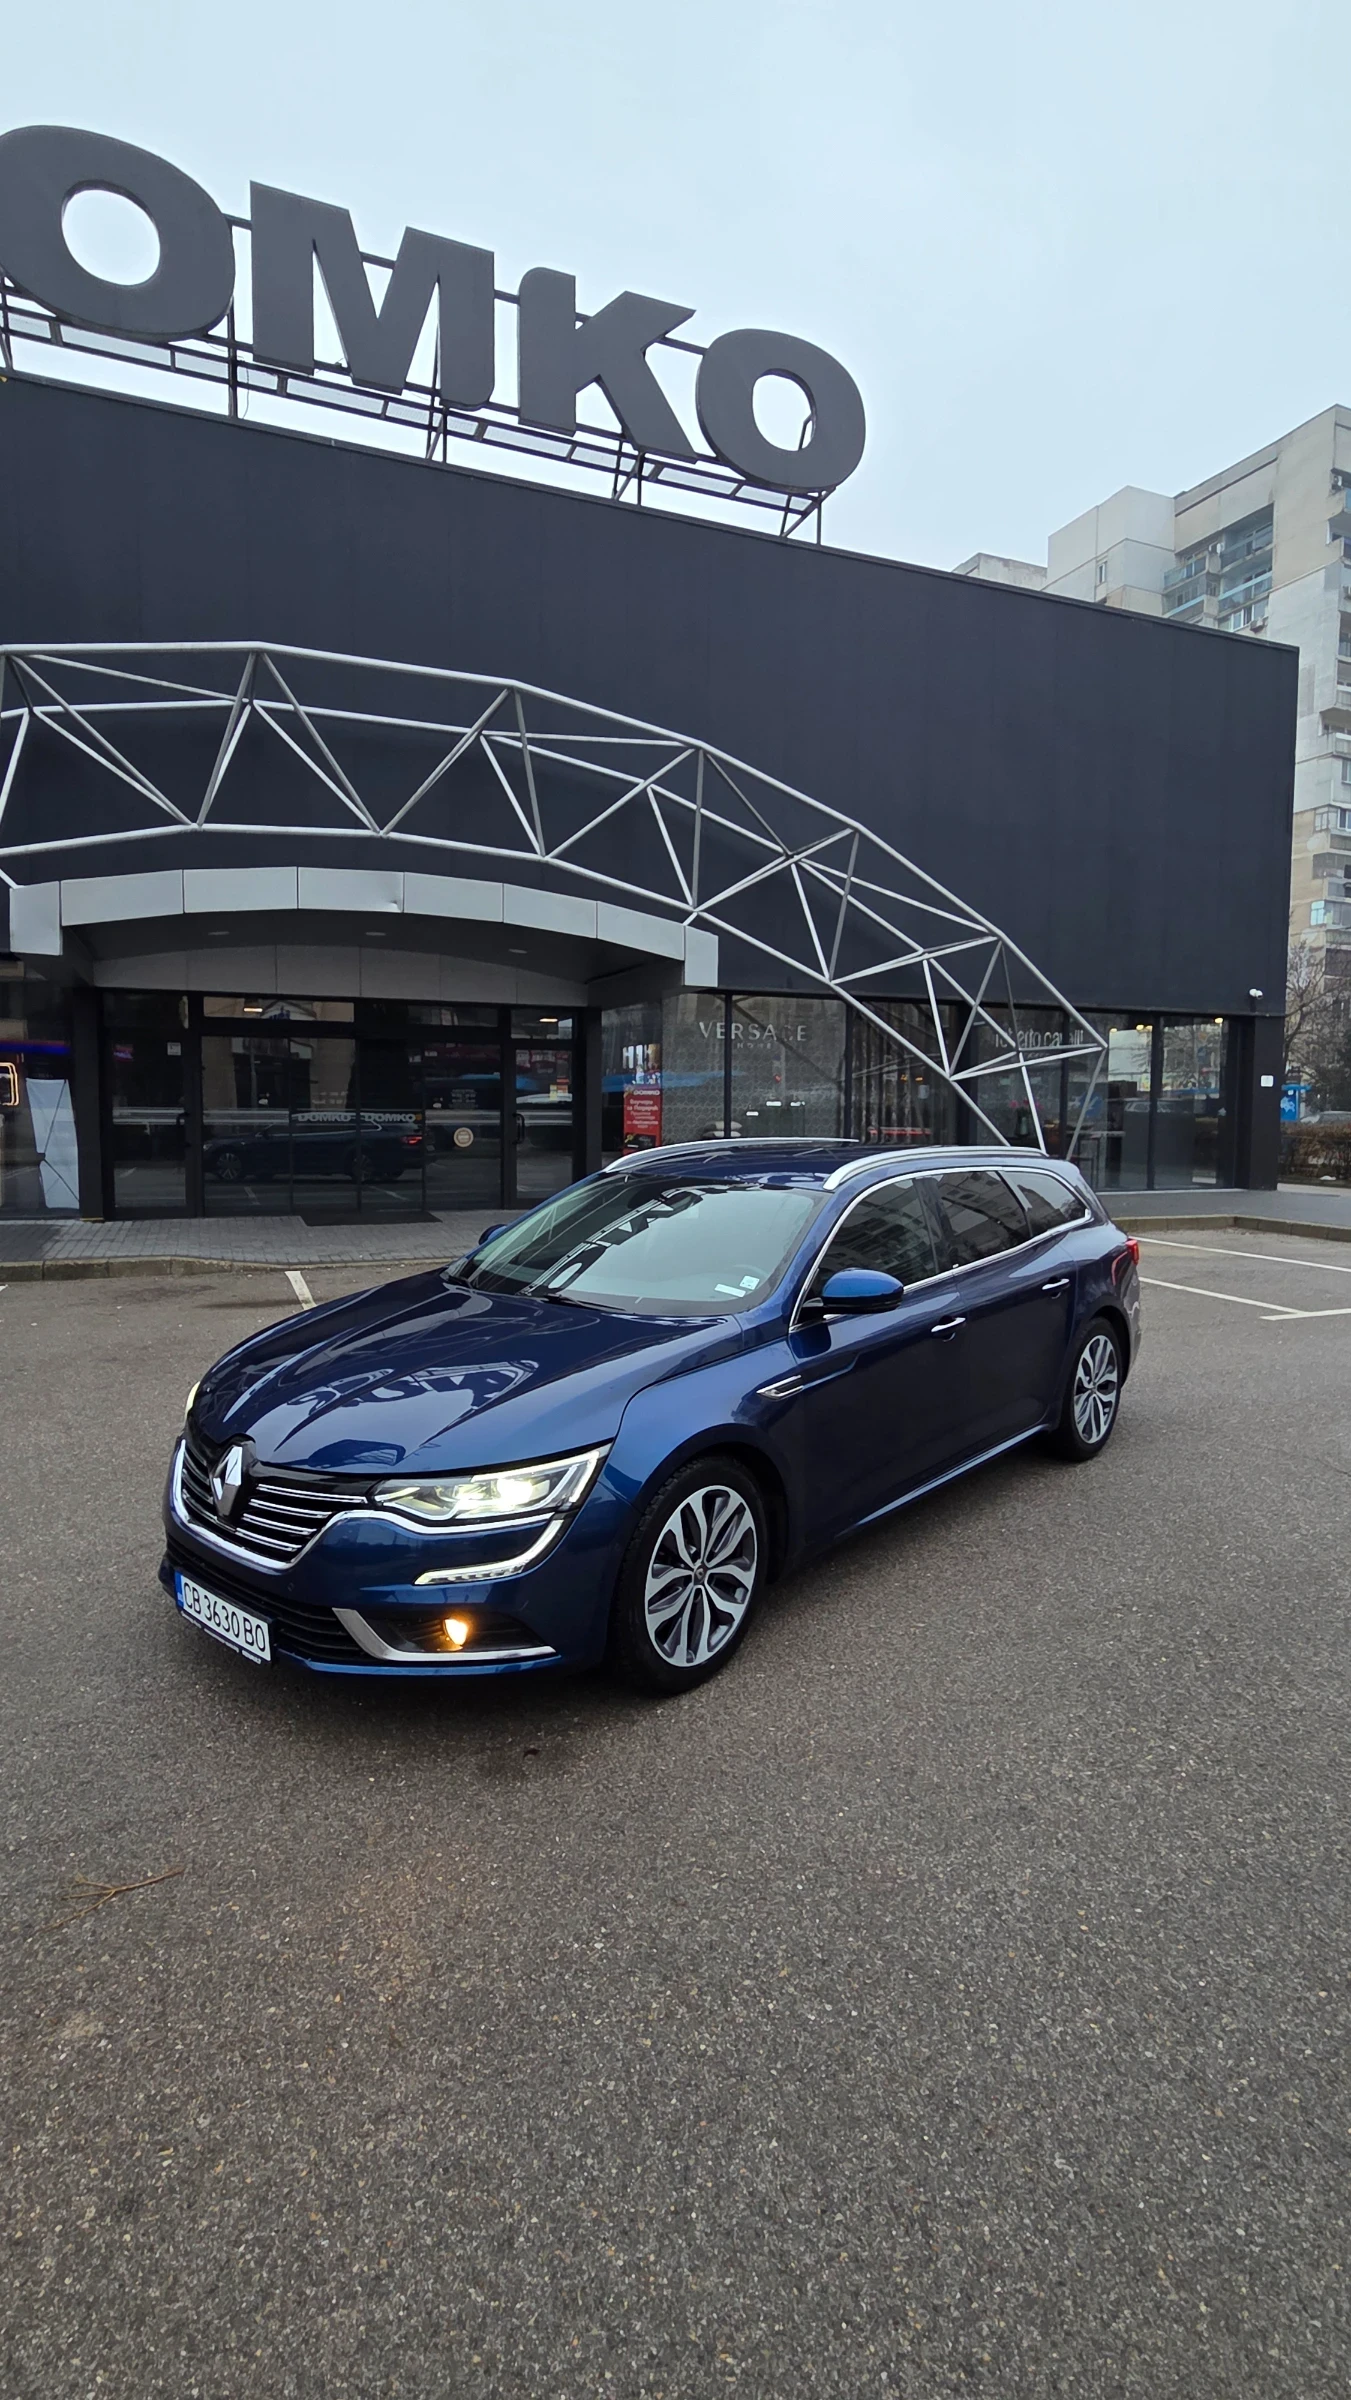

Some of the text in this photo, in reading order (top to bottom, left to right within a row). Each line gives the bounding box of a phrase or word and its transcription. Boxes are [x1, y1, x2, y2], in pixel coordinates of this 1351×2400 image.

[0, 125, 866, 492] OMKO
[297, 1112, 352, 1123] DOMKO
[363, 1112, 417, 1123] DOMKO
[183, 1582, 202, 1615] CB
[203, 1594, 240, 1639] 3630
[242, 1616, 266, 1653] BO
